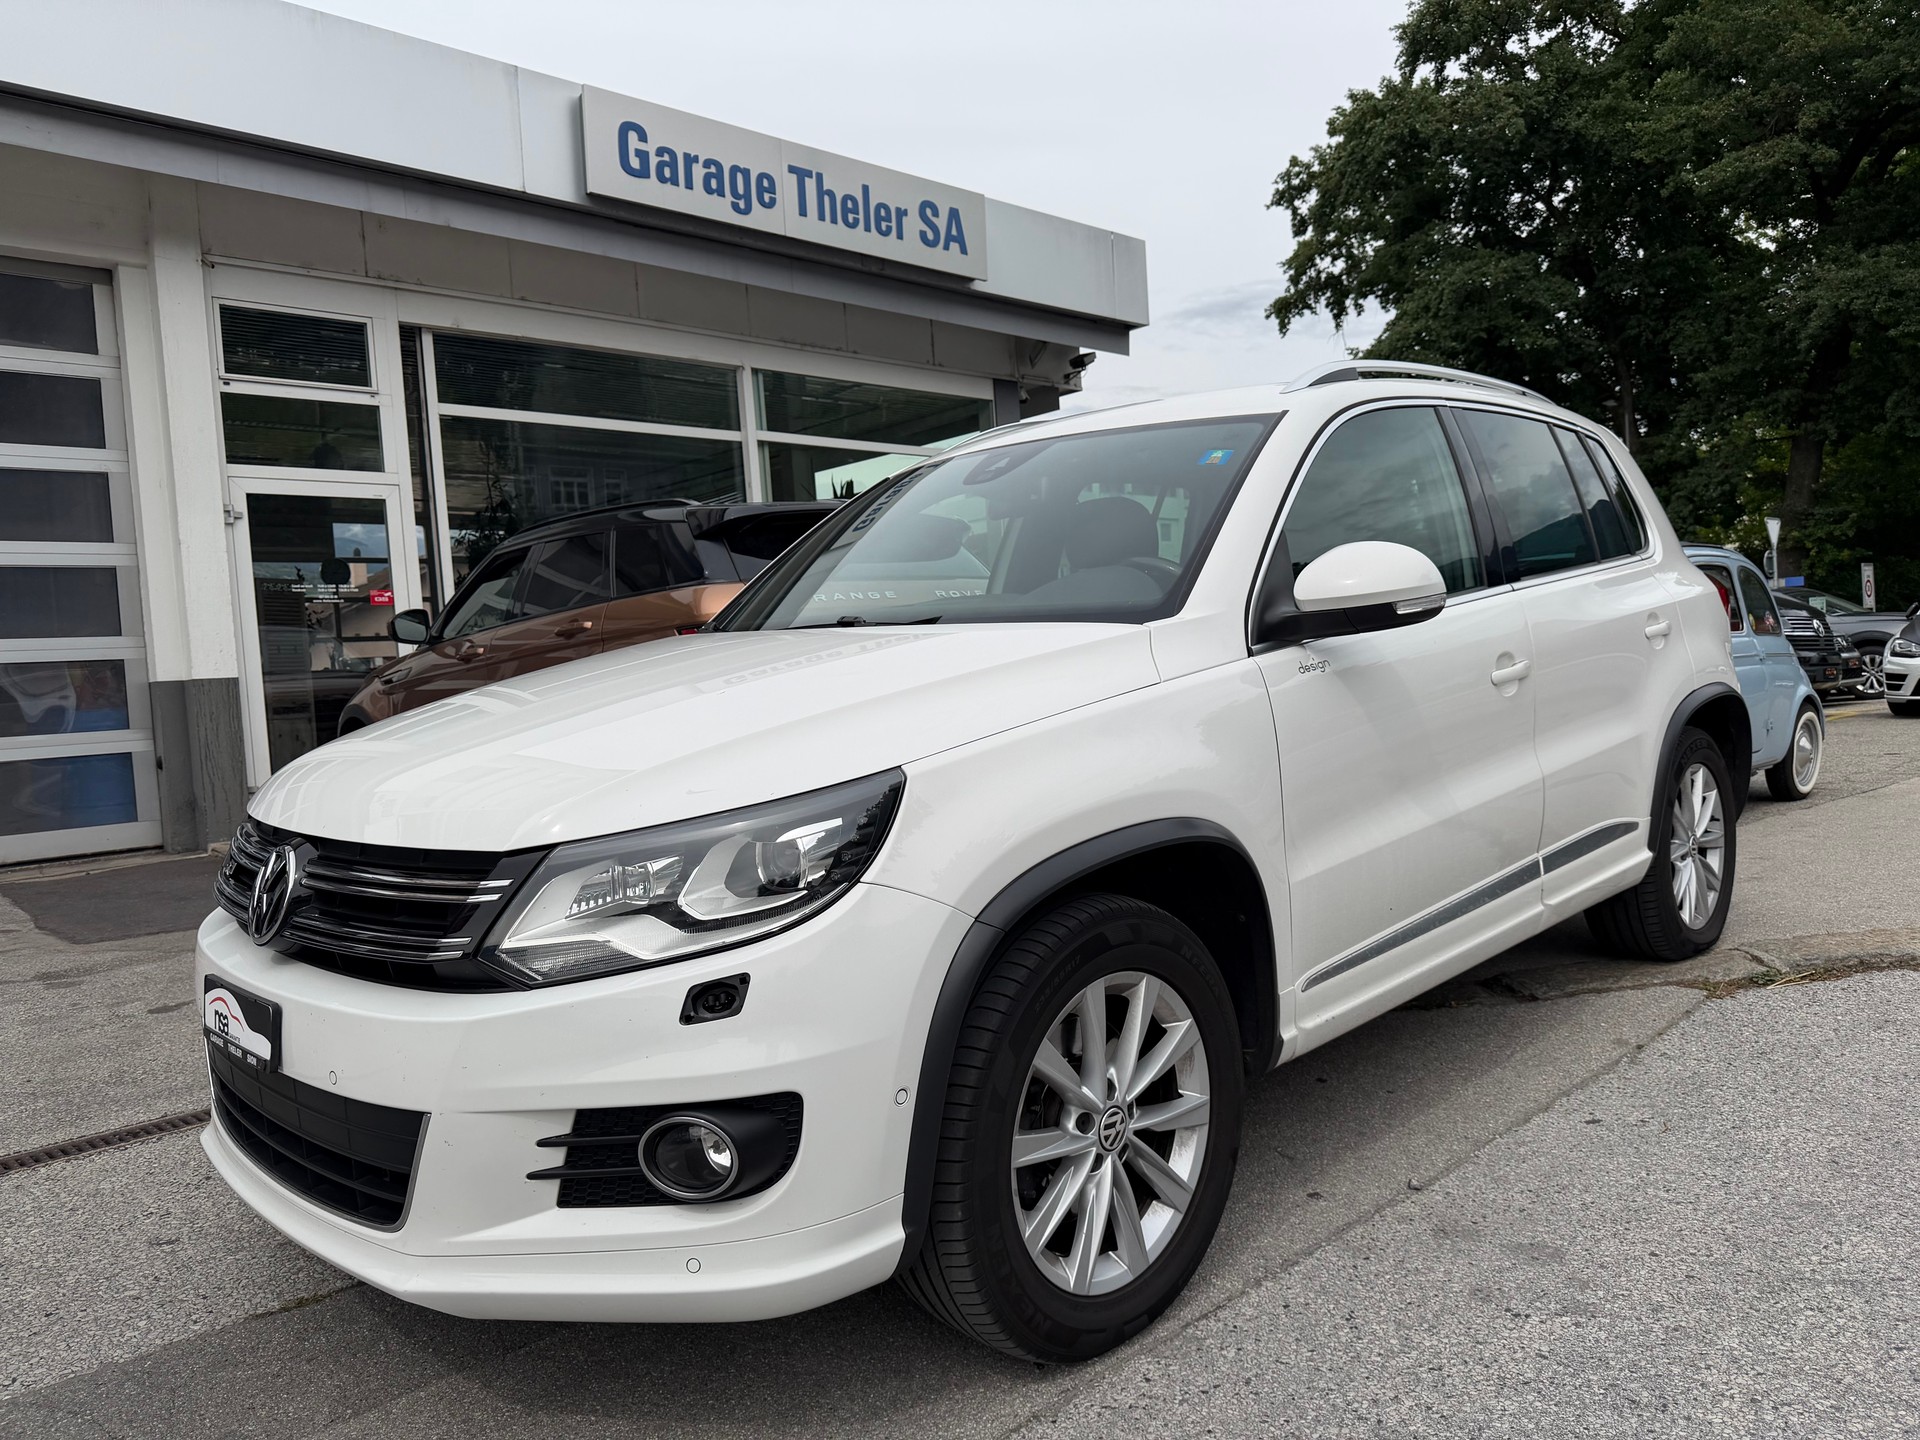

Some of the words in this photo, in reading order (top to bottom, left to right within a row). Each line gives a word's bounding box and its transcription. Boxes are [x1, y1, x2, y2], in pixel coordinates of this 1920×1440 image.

[617, 120, 778, 216] Garage
[787, 164, 909, 241] Theler
[918, 199, 969, 256] SA
[812, 590, 897, 602] RANGE
[1298, 657, 1331, 674] design
[214, 1008, 229, 1036] nsa
